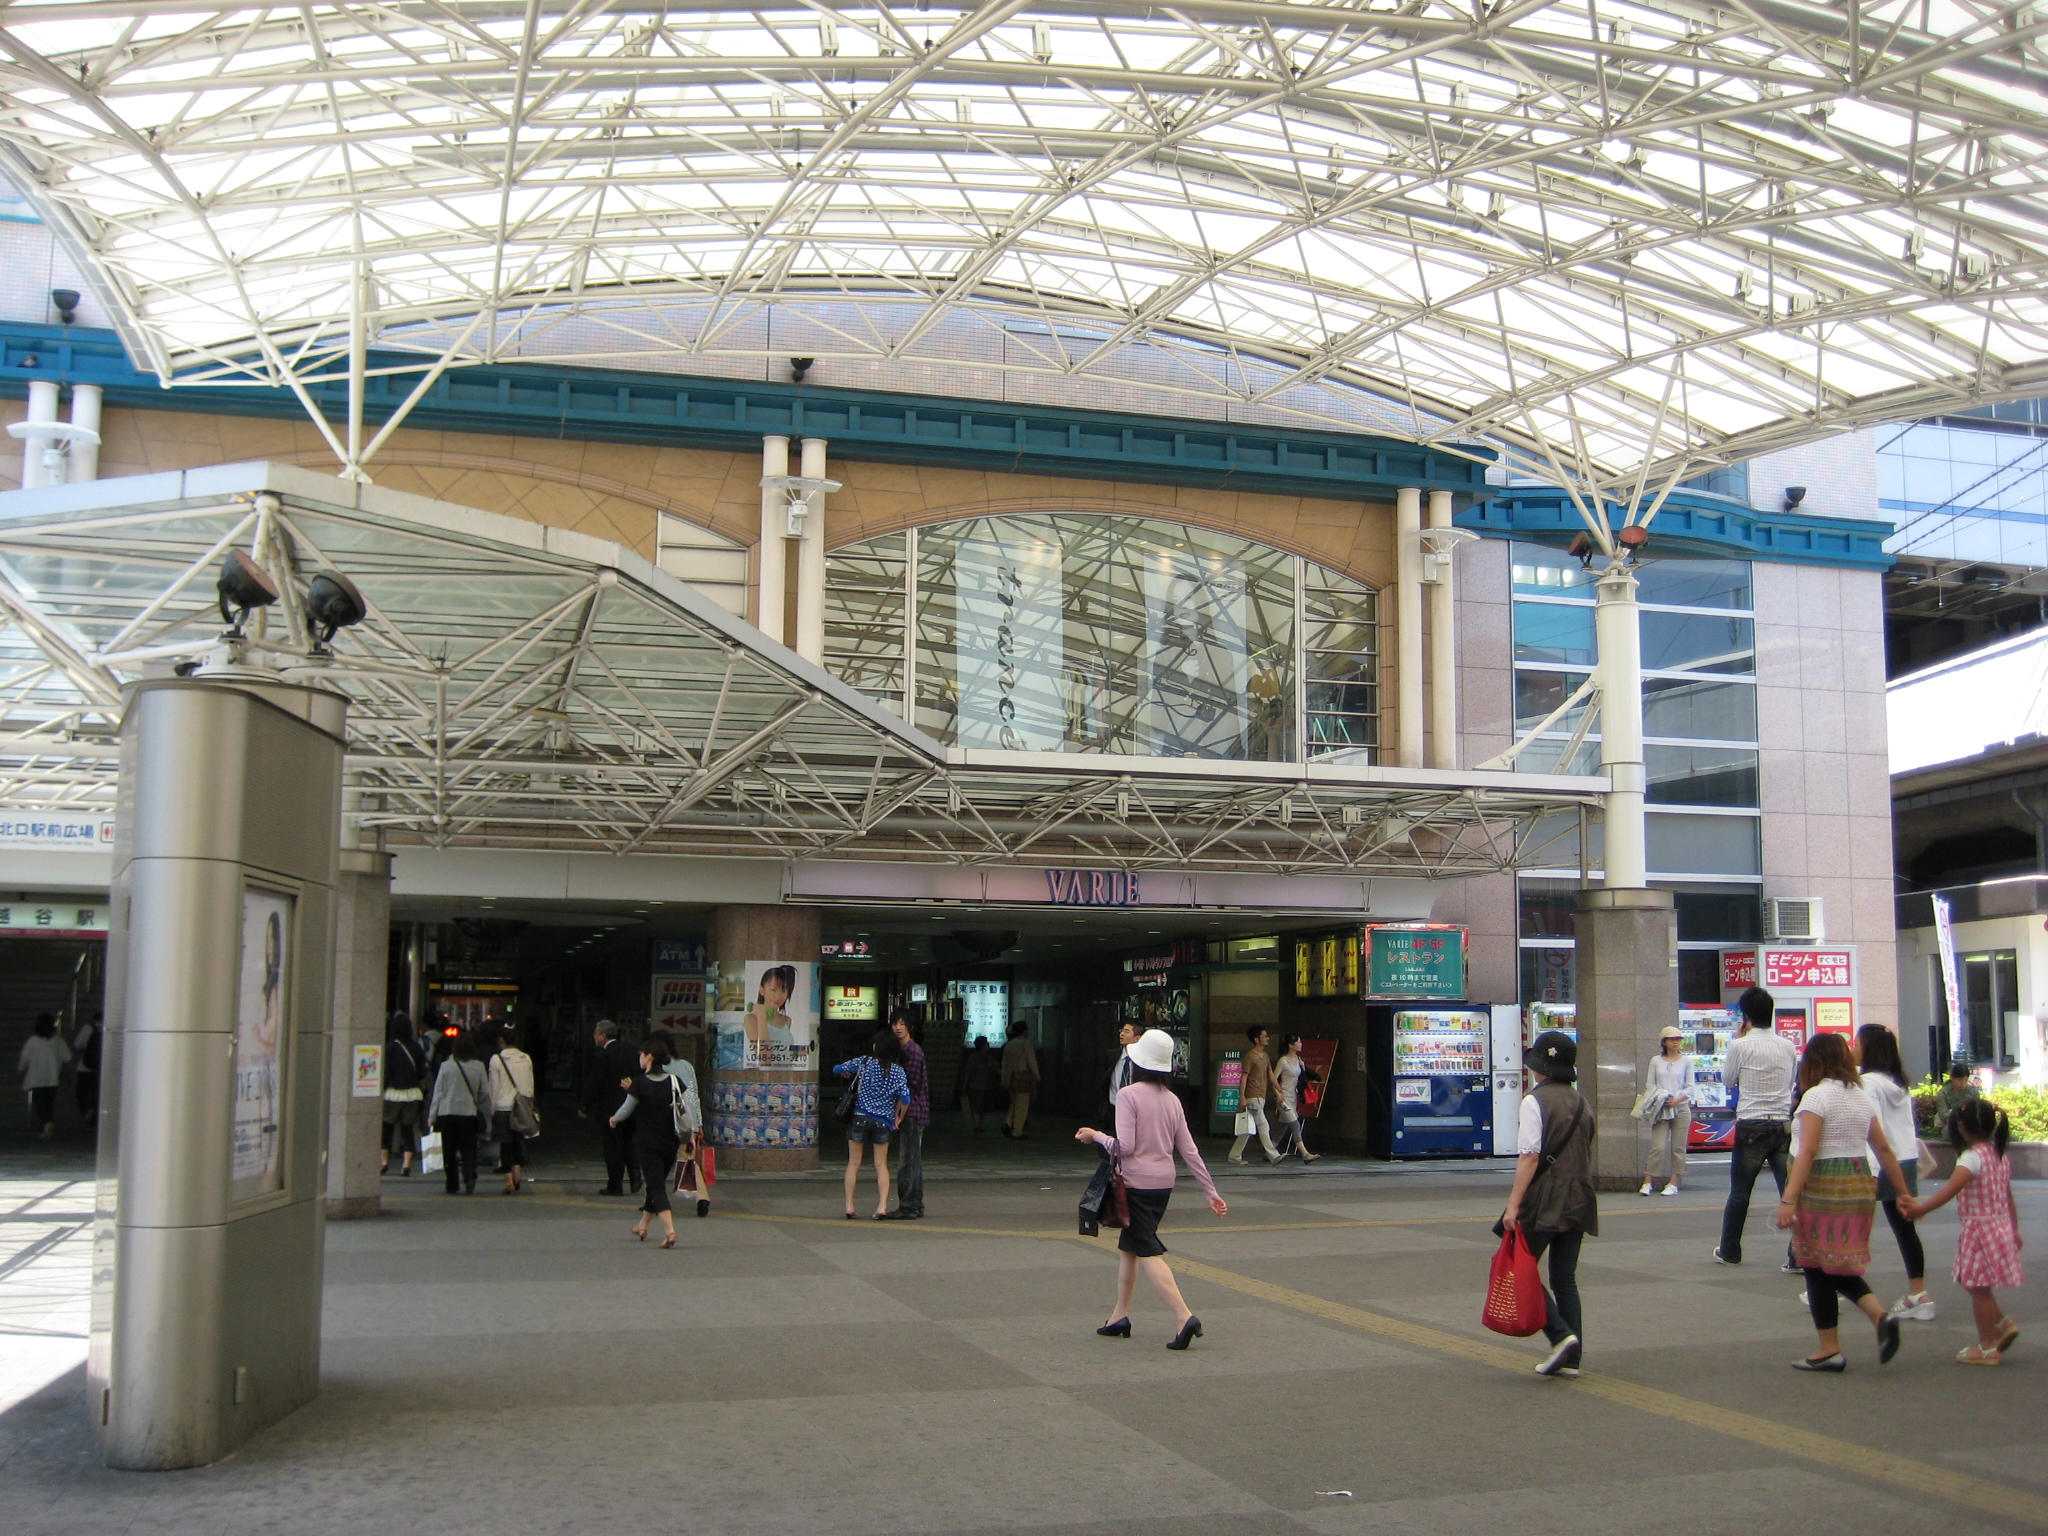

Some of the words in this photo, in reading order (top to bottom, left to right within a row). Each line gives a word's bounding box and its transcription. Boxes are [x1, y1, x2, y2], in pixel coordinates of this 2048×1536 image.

[0, 823, 94, 838] 北口駅前広場
[1046, 869, 1141, 906] VARIE
[1387, 939, 1409, 948] VARIE
[659, 950, 690, 960] ATM
[1387, 952, 1445, 964] レストラン
[1767, 954, 1813, 966] モビット
[1724, 958, 1743, 966] モビット
[1767, 967, 1848, 984] ローン申込機
[959, 984, 1007, 994] 東武不動産
[1545, 968, 1557, 1003] 路上喫
